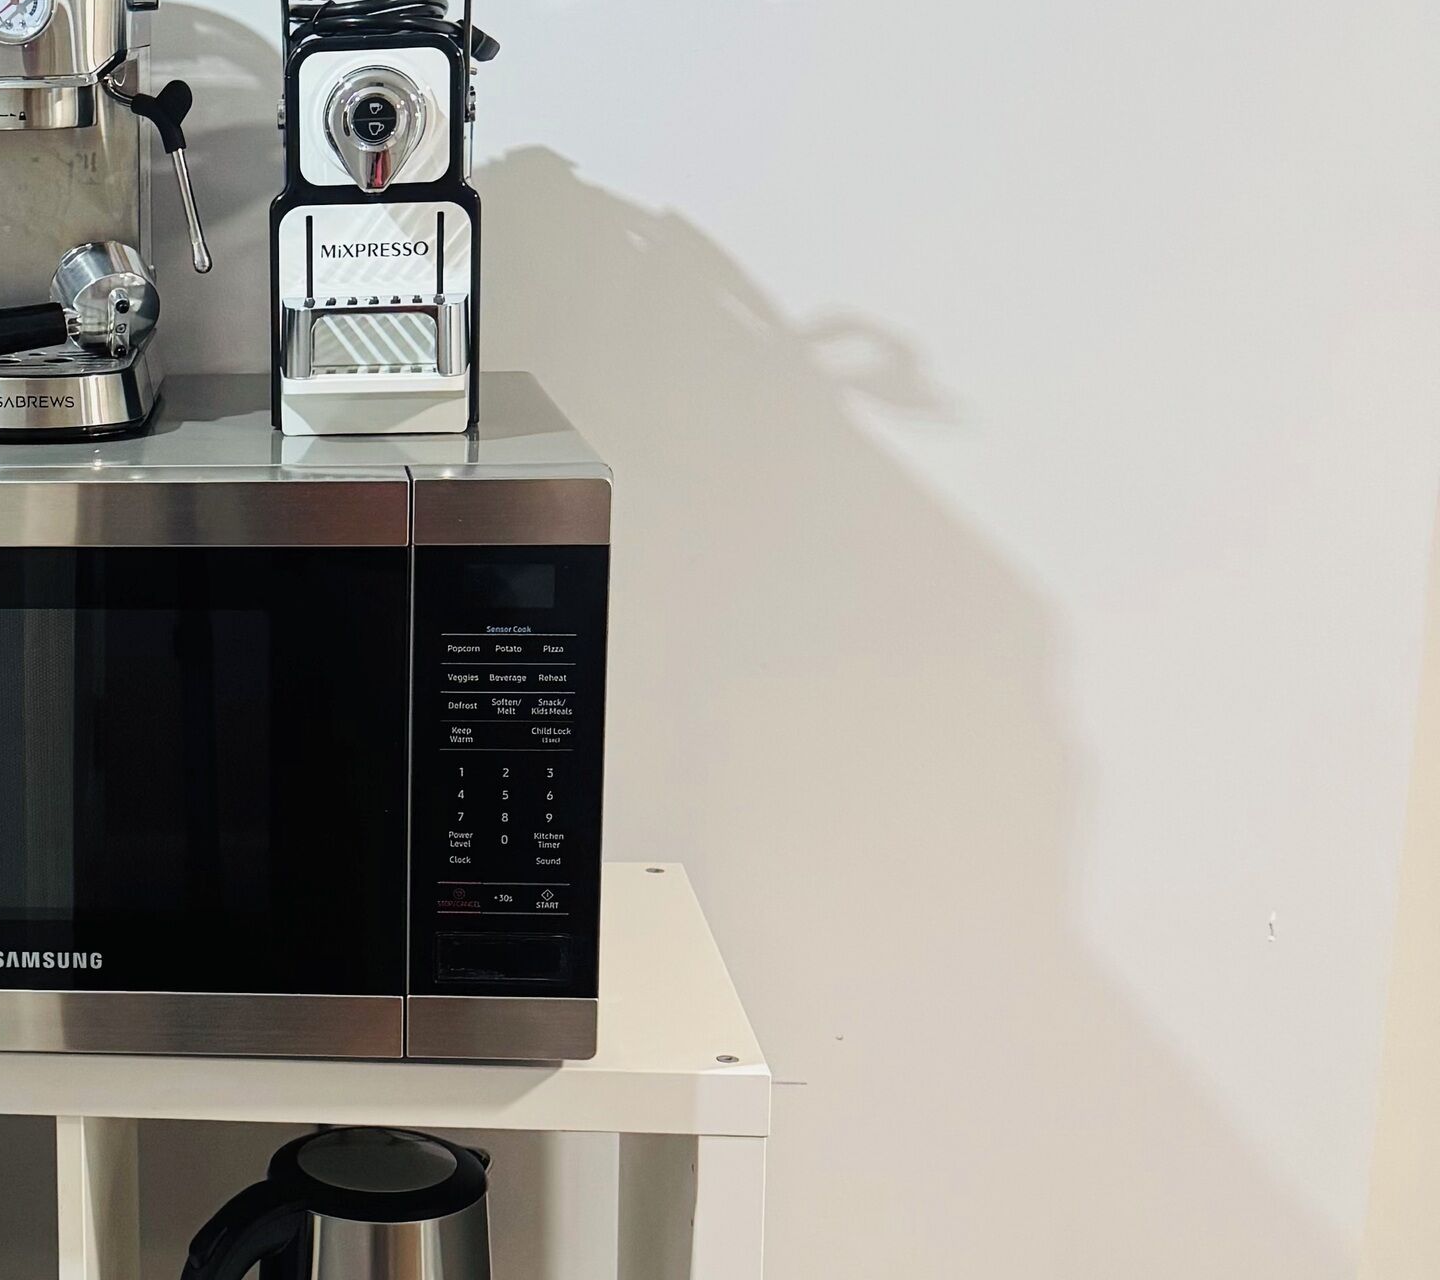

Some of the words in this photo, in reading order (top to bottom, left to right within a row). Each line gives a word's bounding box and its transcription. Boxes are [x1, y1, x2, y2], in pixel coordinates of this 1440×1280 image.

[320, 241, 429, 259] MiXPRESSO
[486, 625, 511, 633] Sensor
[513, 625, 532, 633] Cook
[447, 644, 481, 654] Popcorn
[495, 644, 523, 653] Potato
[543, 644, 564, 653] Pizza
[447, 673, 479, 684] Veggies
[489, 673, 527, 684] Beverage
[538, 673, 567, 682] Reheat
[448, 701, 478, 710] Defrost
[491, 697, 522, 707] Soften/
[538, 698, 566, 707] Snack/
[497, 707, 516, 715] Melt
[531, 707, 549, 715] Kids
[548, 707, 573, 716] Meals
[451, 726, 472, 736] Keep
[531, 726, 552, 735] Child
[553, 727, 572, 735] Lock
[449, 735, 474, 743] Warm
[502, 767, 510, 778] 2
[546, 767, 554, 778] 3
[457, 789, 465, 799] 4
[502, 790, 509, 800] 5
[546, 790, 554, 801] 6
[457, 811, 465, 822] 7
[501, 812, 509, 823] 8
[545, 812, 553, 823] 9
[448, 830, 474, 839] Power
[533, 832, 565, 840] Kitchen
[449, 839, 471, 848] Level
[500, 834, 509, 845] 0
[537, 840, 561, 849] Timer
[449, 855, 472, 864] Clock
[535, 856, 561, 865] Sound
[535, 901, 560, 909] START
